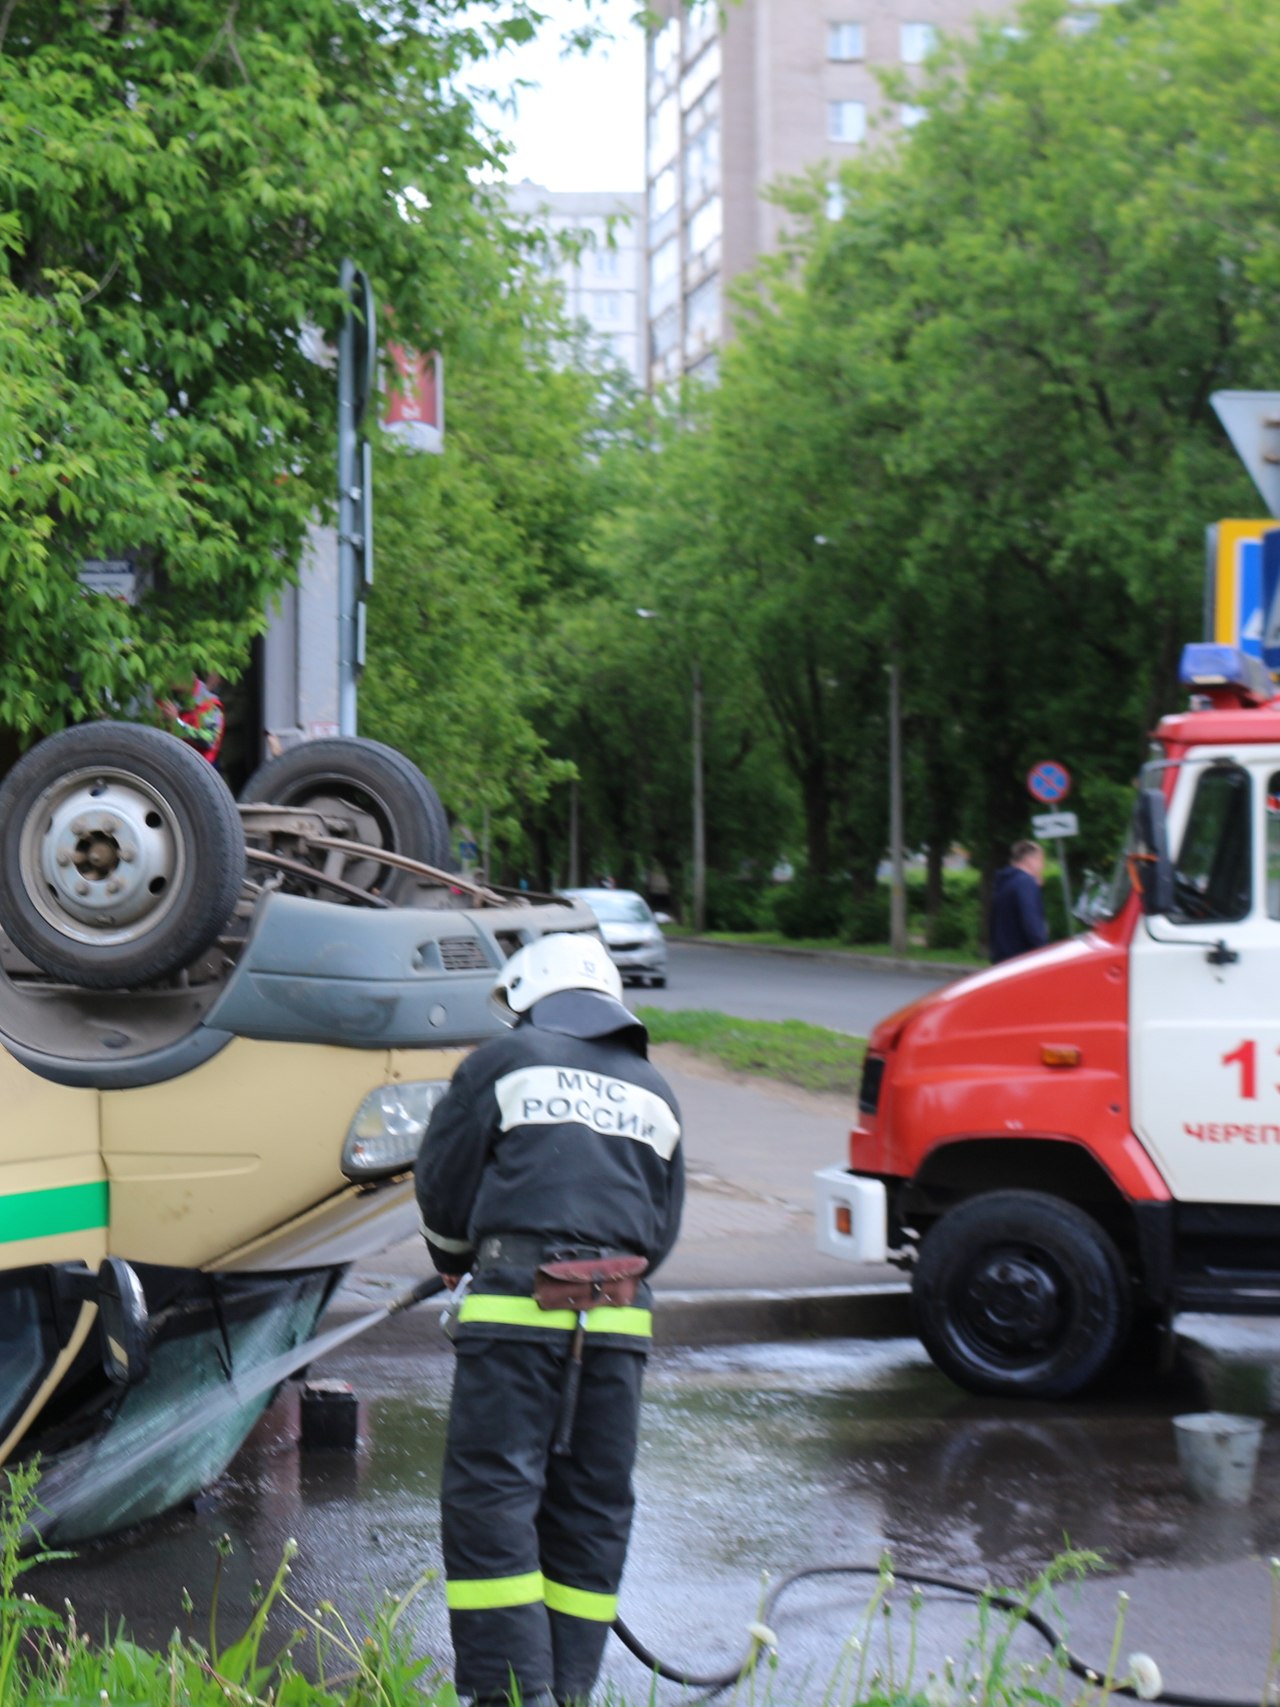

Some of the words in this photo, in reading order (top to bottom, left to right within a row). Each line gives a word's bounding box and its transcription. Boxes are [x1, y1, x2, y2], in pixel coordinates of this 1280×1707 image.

[558, 1071, 628, 1104] МЧС
[1221, 1040, 1280, 1099] 1
[522, 1097, 656, 1139] РОССИИ
